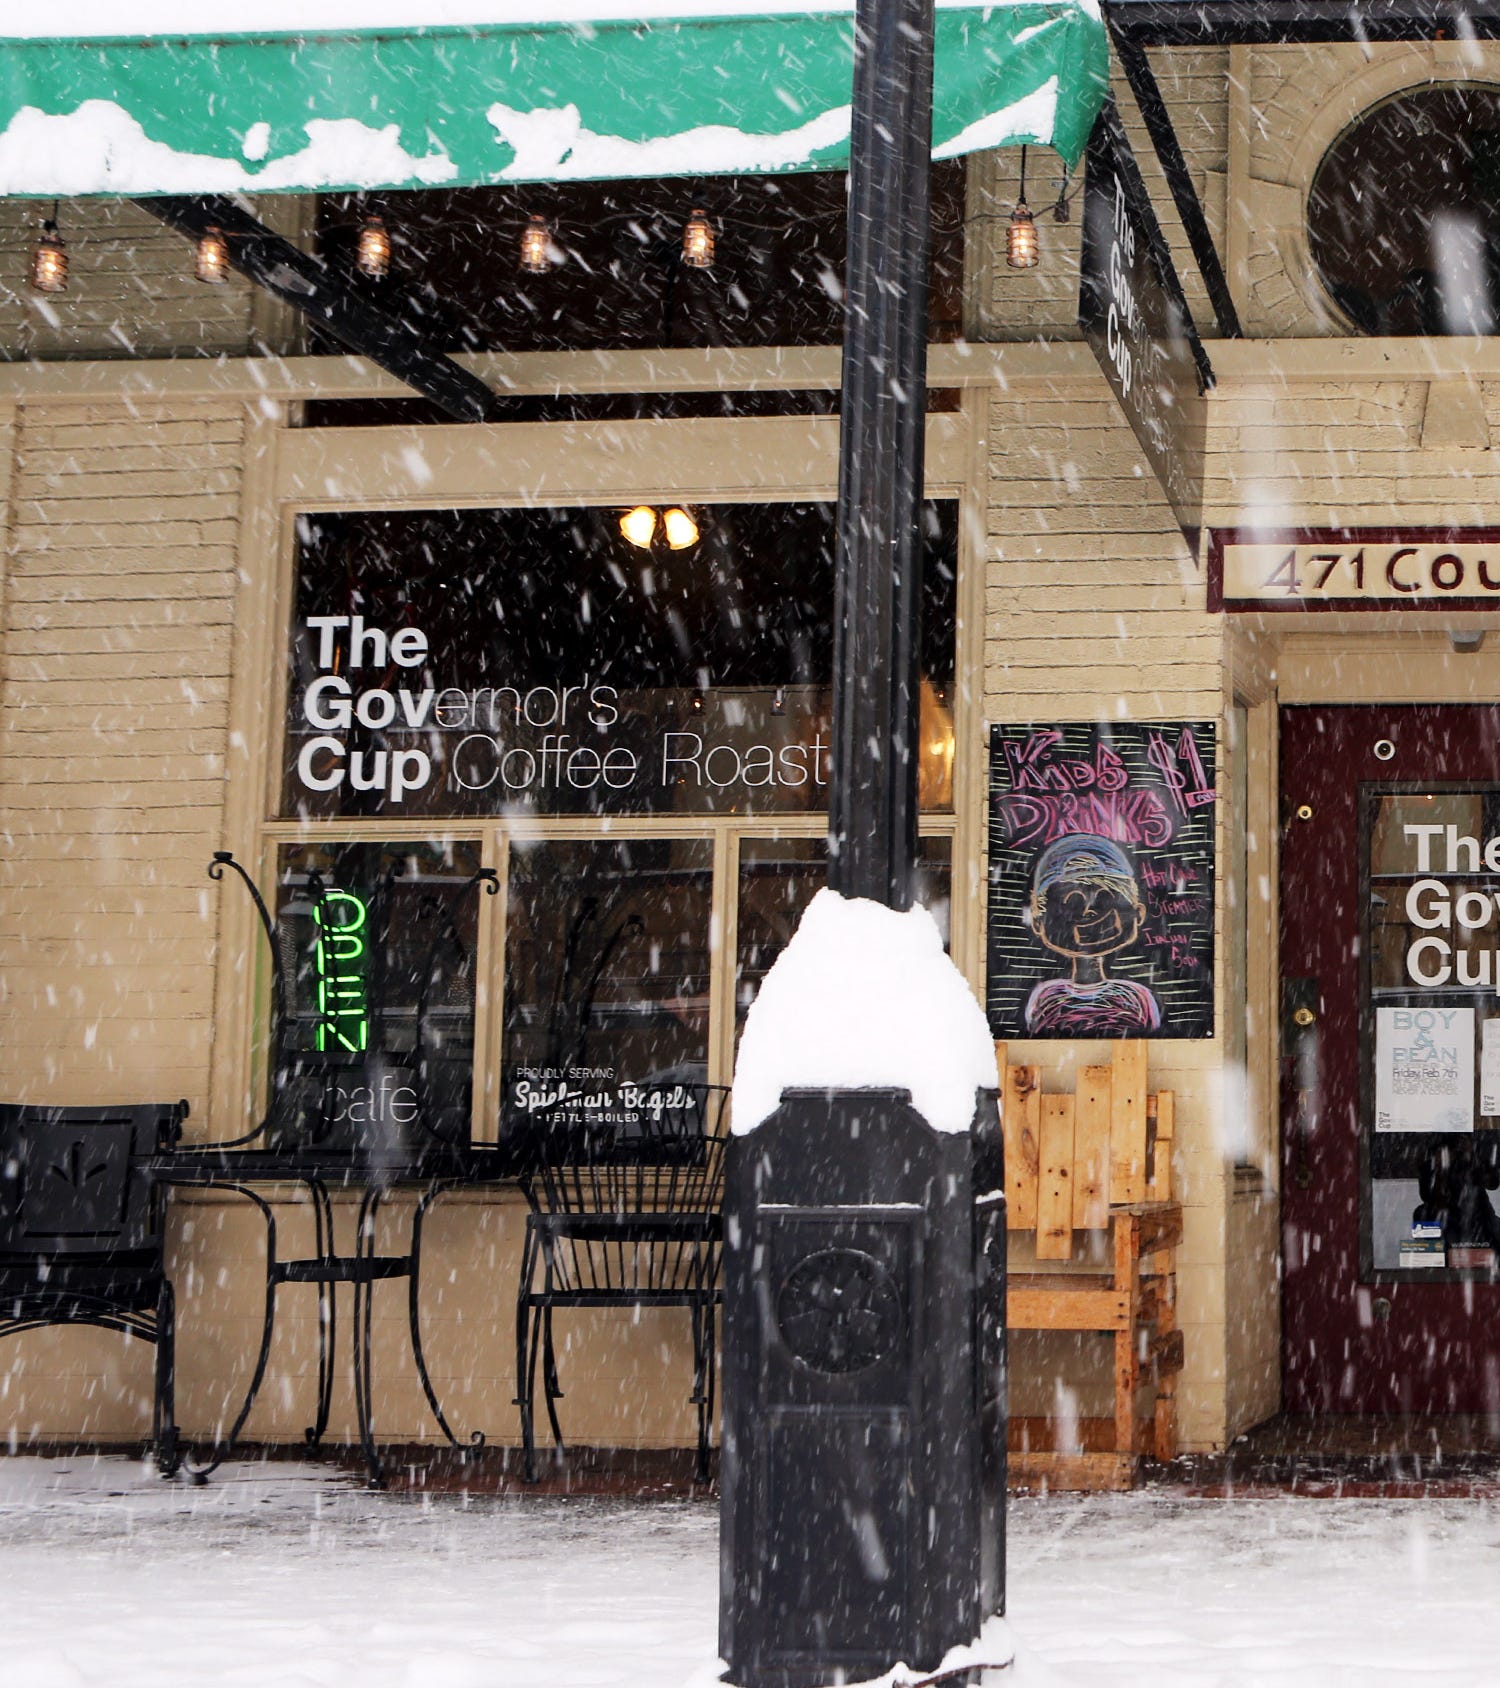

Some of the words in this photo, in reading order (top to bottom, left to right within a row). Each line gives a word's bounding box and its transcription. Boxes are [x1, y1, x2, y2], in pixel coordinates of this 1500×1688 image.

[1113, 172, 1135, 269] The
[1107, 303, 1133, 398] Cup
[1259, 547, 1365, 594] 471
[306, 616, 429, 668] The
[303, 673, 619, 730] Governor's
[297, 737, 432, 803] Cup
[453, 733, 638, 790] Coffee
[312, 893, 368, 1052] OPEN
[1393, 1010, 1458, 1030] BOY
[516, 1067, 566, 1079] PROUDLY
[568, 1067, 614, 1079] SERVING
[1392, 1047, 1458, 1063] BEAN
[1441, 1067, 1458, 1079] 7th
[515, 1080, 613, 1113] Spielman
[617, 1080, 697, 1121] Bagels
